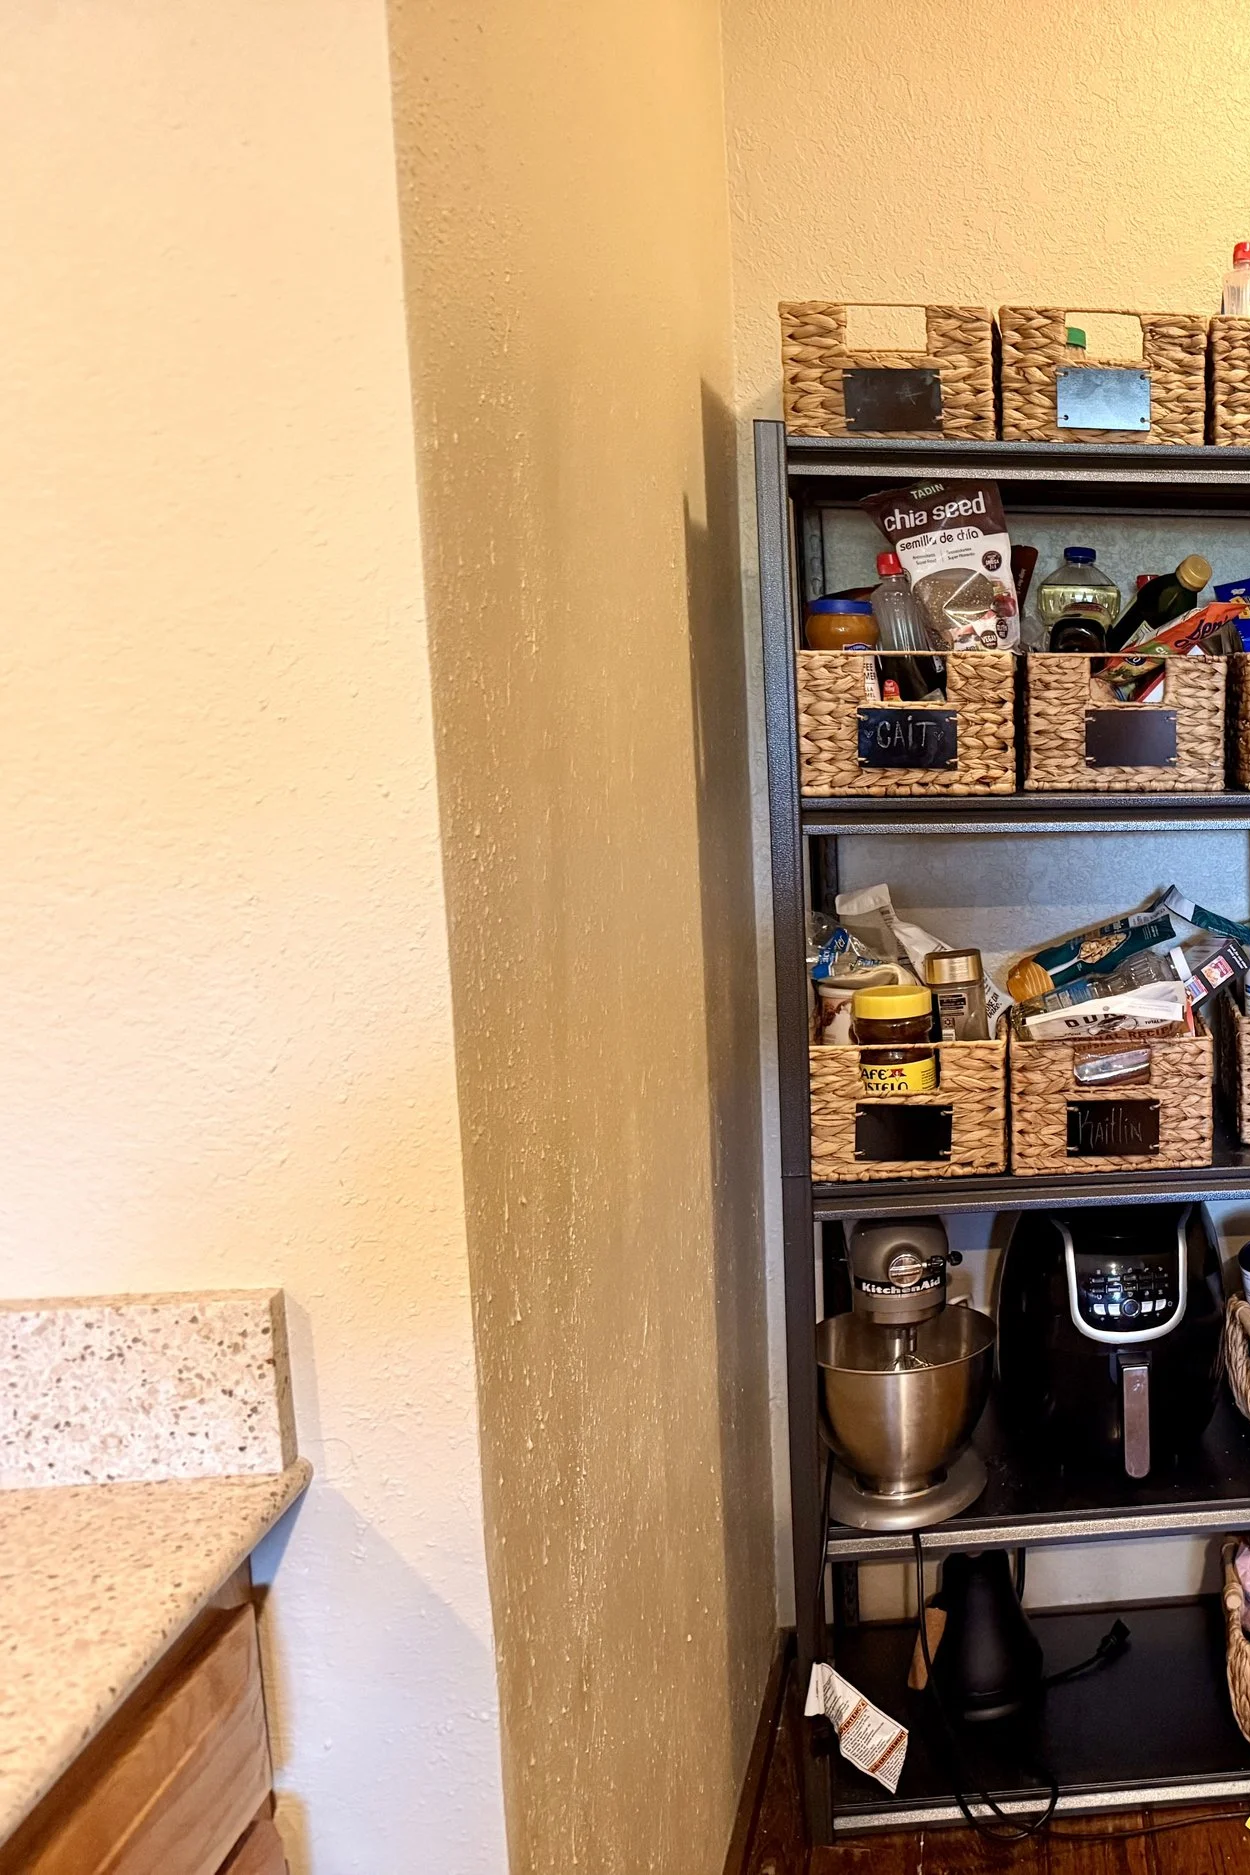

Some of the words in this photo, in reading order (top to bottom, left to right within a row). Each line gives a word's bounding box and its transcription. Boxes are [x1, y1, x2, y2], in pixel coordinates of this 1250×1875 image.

[910, 483, 945, 500] TADIN
[884, 508, 928, 532] chia
[932, 490, 986, 521] seed
[900, 534, 938, 552] semilla
[939, 531, 954, 544] de
[861, 1277, 941, 1294] KitchenAid
